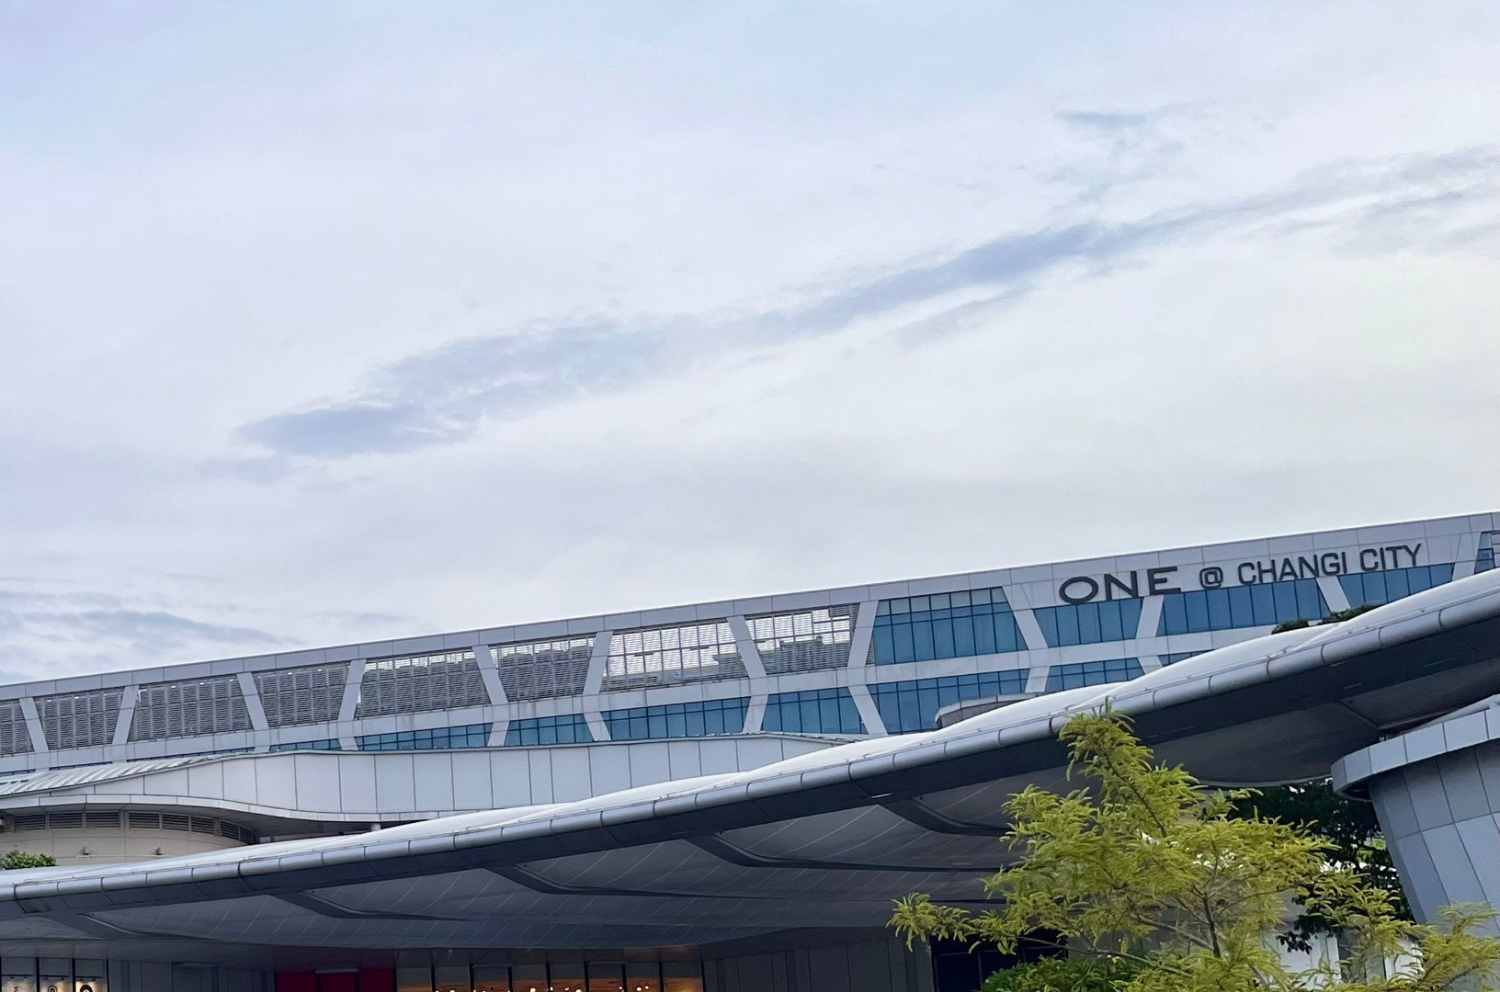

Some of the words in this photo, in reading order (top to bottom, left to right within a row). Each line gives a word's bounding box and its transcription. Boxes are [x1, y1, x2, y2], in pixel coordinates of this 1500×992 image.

[1059, 566, 1181, 605] ONE
[1237, 550, 1348, 586] CHANGI
[1360, 543, 1423, 573] CITY
